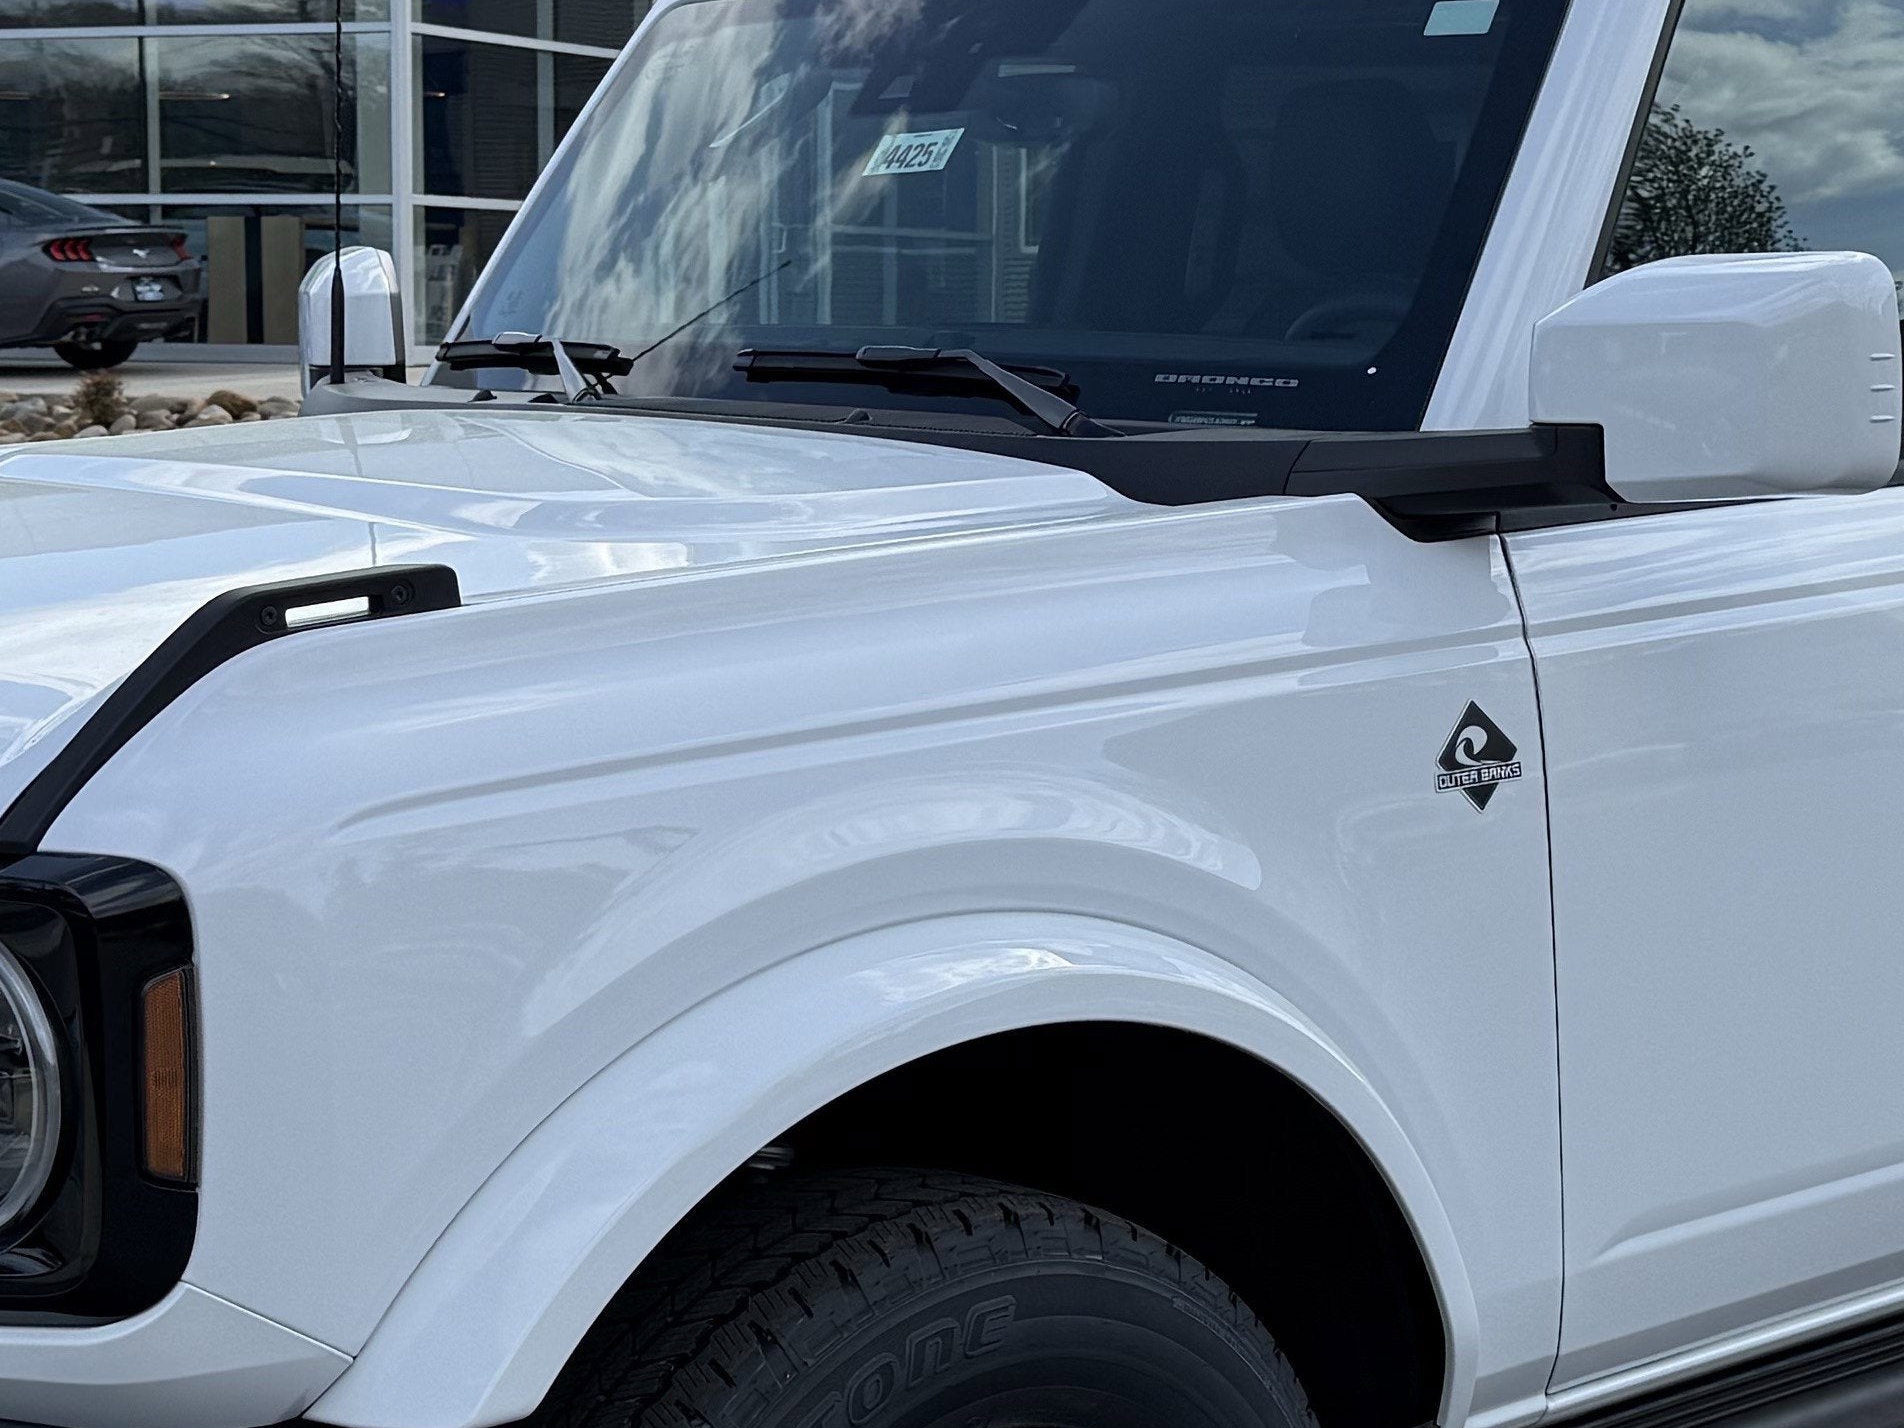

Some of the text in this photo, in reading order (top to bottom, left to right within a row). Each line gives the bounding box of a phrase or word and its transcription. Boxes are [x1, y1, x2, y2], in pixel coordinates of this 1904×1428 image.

[885, 142, 939, 170] 4425
[1439, 764, 1520, 788] OUTER BANKS
